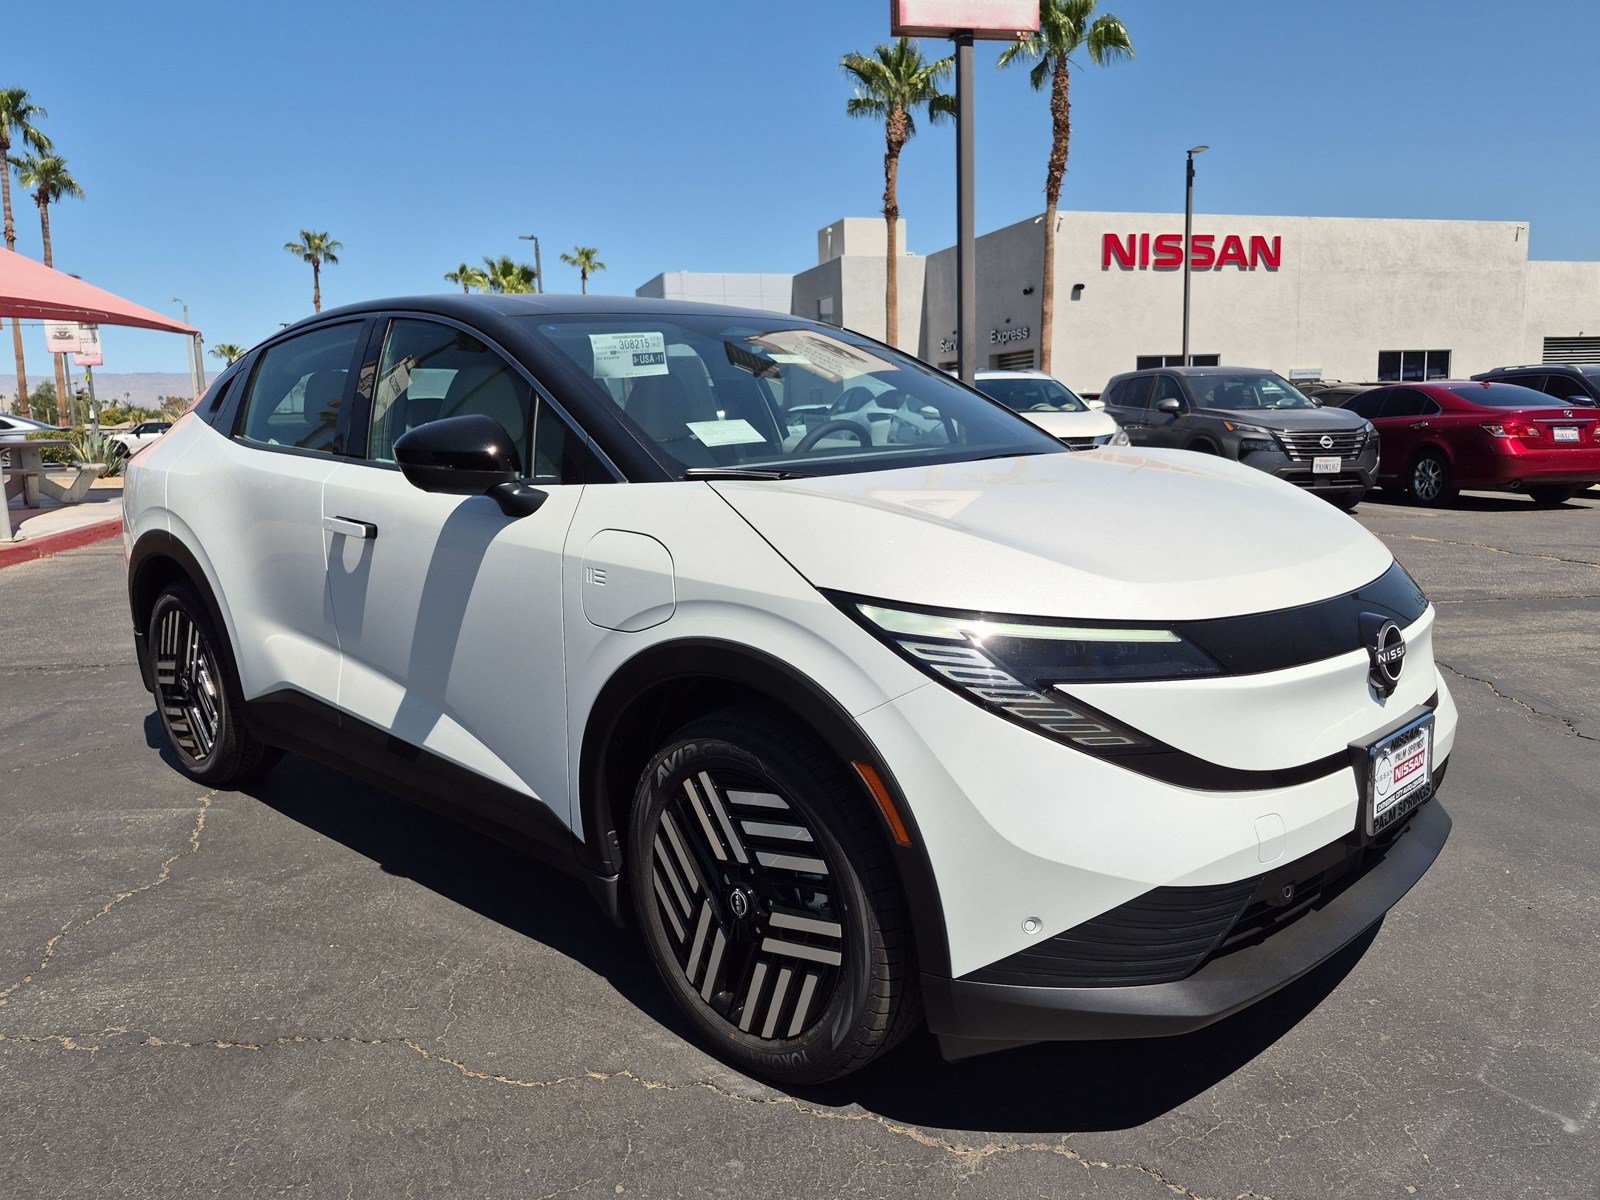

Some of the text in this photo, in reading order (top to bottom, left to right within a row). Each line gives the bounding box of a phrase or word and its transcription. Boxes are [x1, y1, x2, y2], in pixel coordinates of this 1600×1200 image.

[1102, 233, 1282, 270] NISSAN
[619, 338, 650, 350] 308215
[990, 327, 1030, 345] Express
[940, 340, 958, 352] Serv
[640, 354, 655, 364] USA
[1377, 645, 1405, 664] NISS
[1395, 753, 1424, 780] NISSAN
[1373, 782, 1431, 833] PALM SPRINGS
